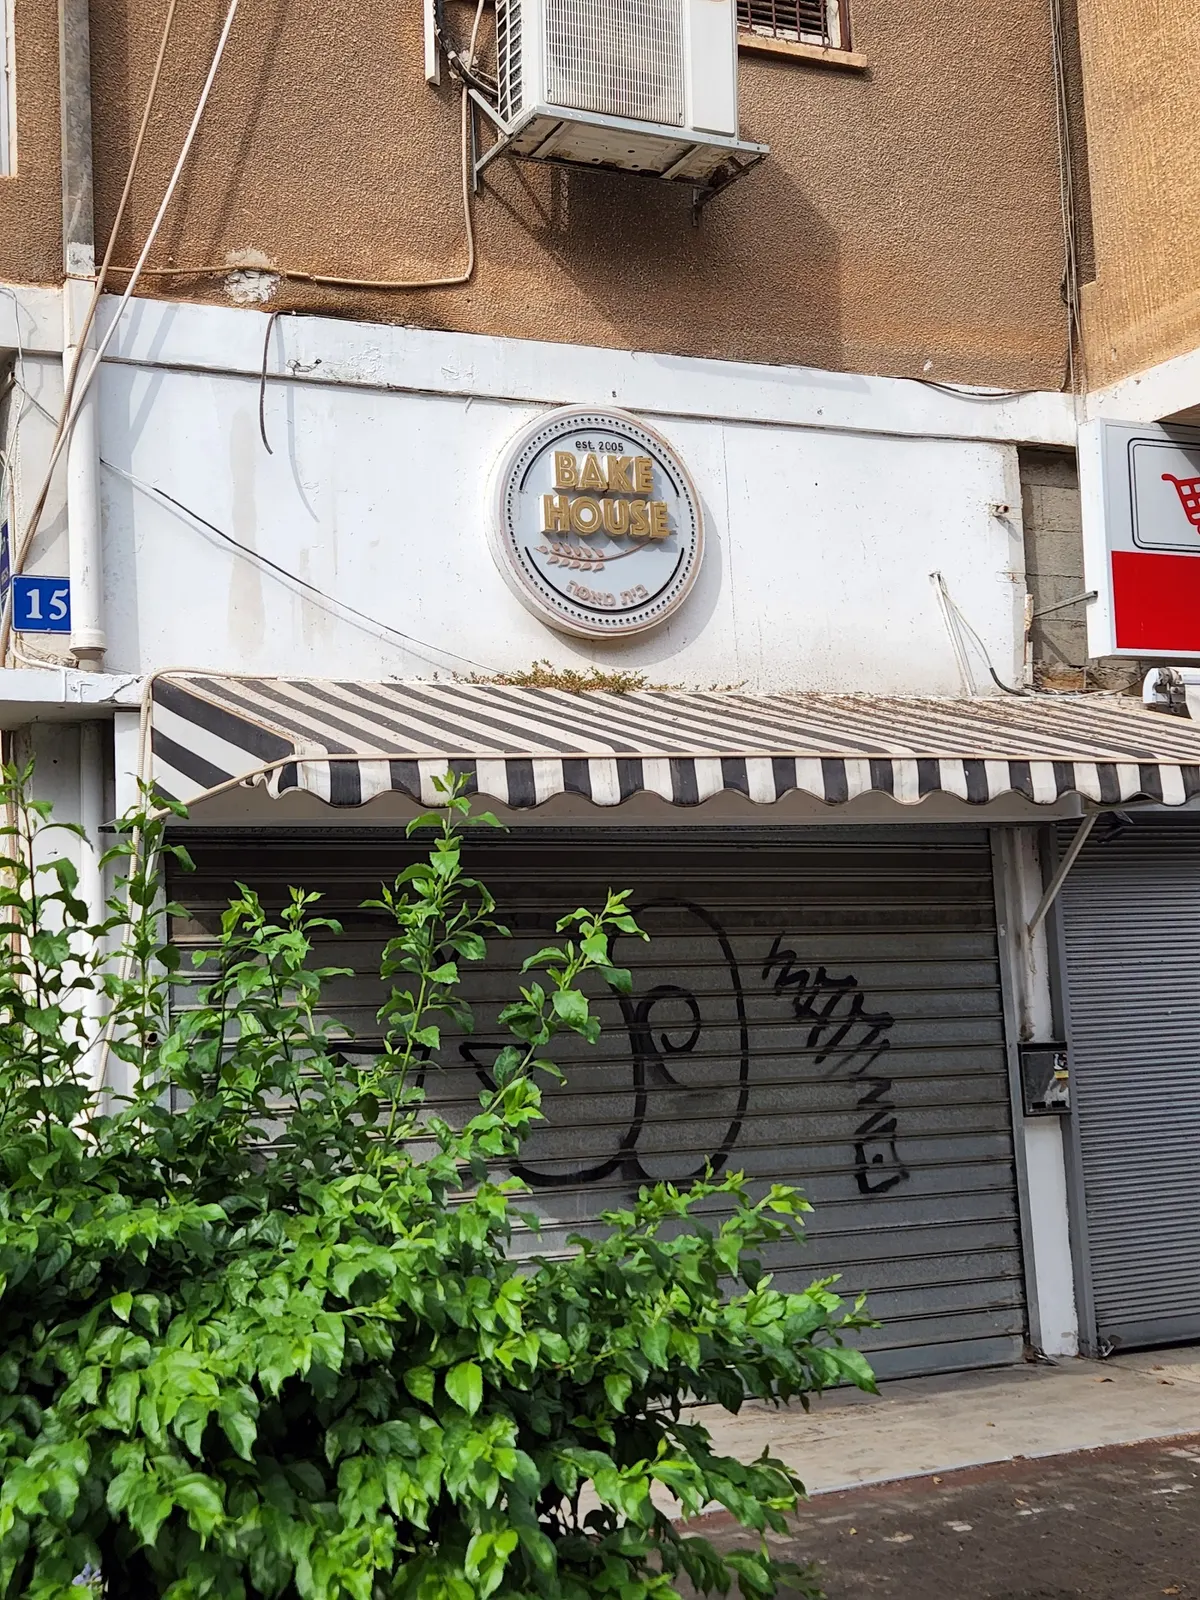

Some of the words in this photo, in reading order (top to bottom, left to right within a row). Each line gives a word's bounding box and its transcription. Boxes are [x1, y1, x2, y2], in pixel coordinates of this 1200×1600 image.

[575, 440, 595, 450] est.
[598, 441, 624, 452] 2005
[551, 451, 654, 493] BAKE
[541, 494, 670, 538] HOUSE
[26, 588, 69, 620] 15
[566, 580, 616, 606] מאפה
[620, 584, 649, 605] בית
